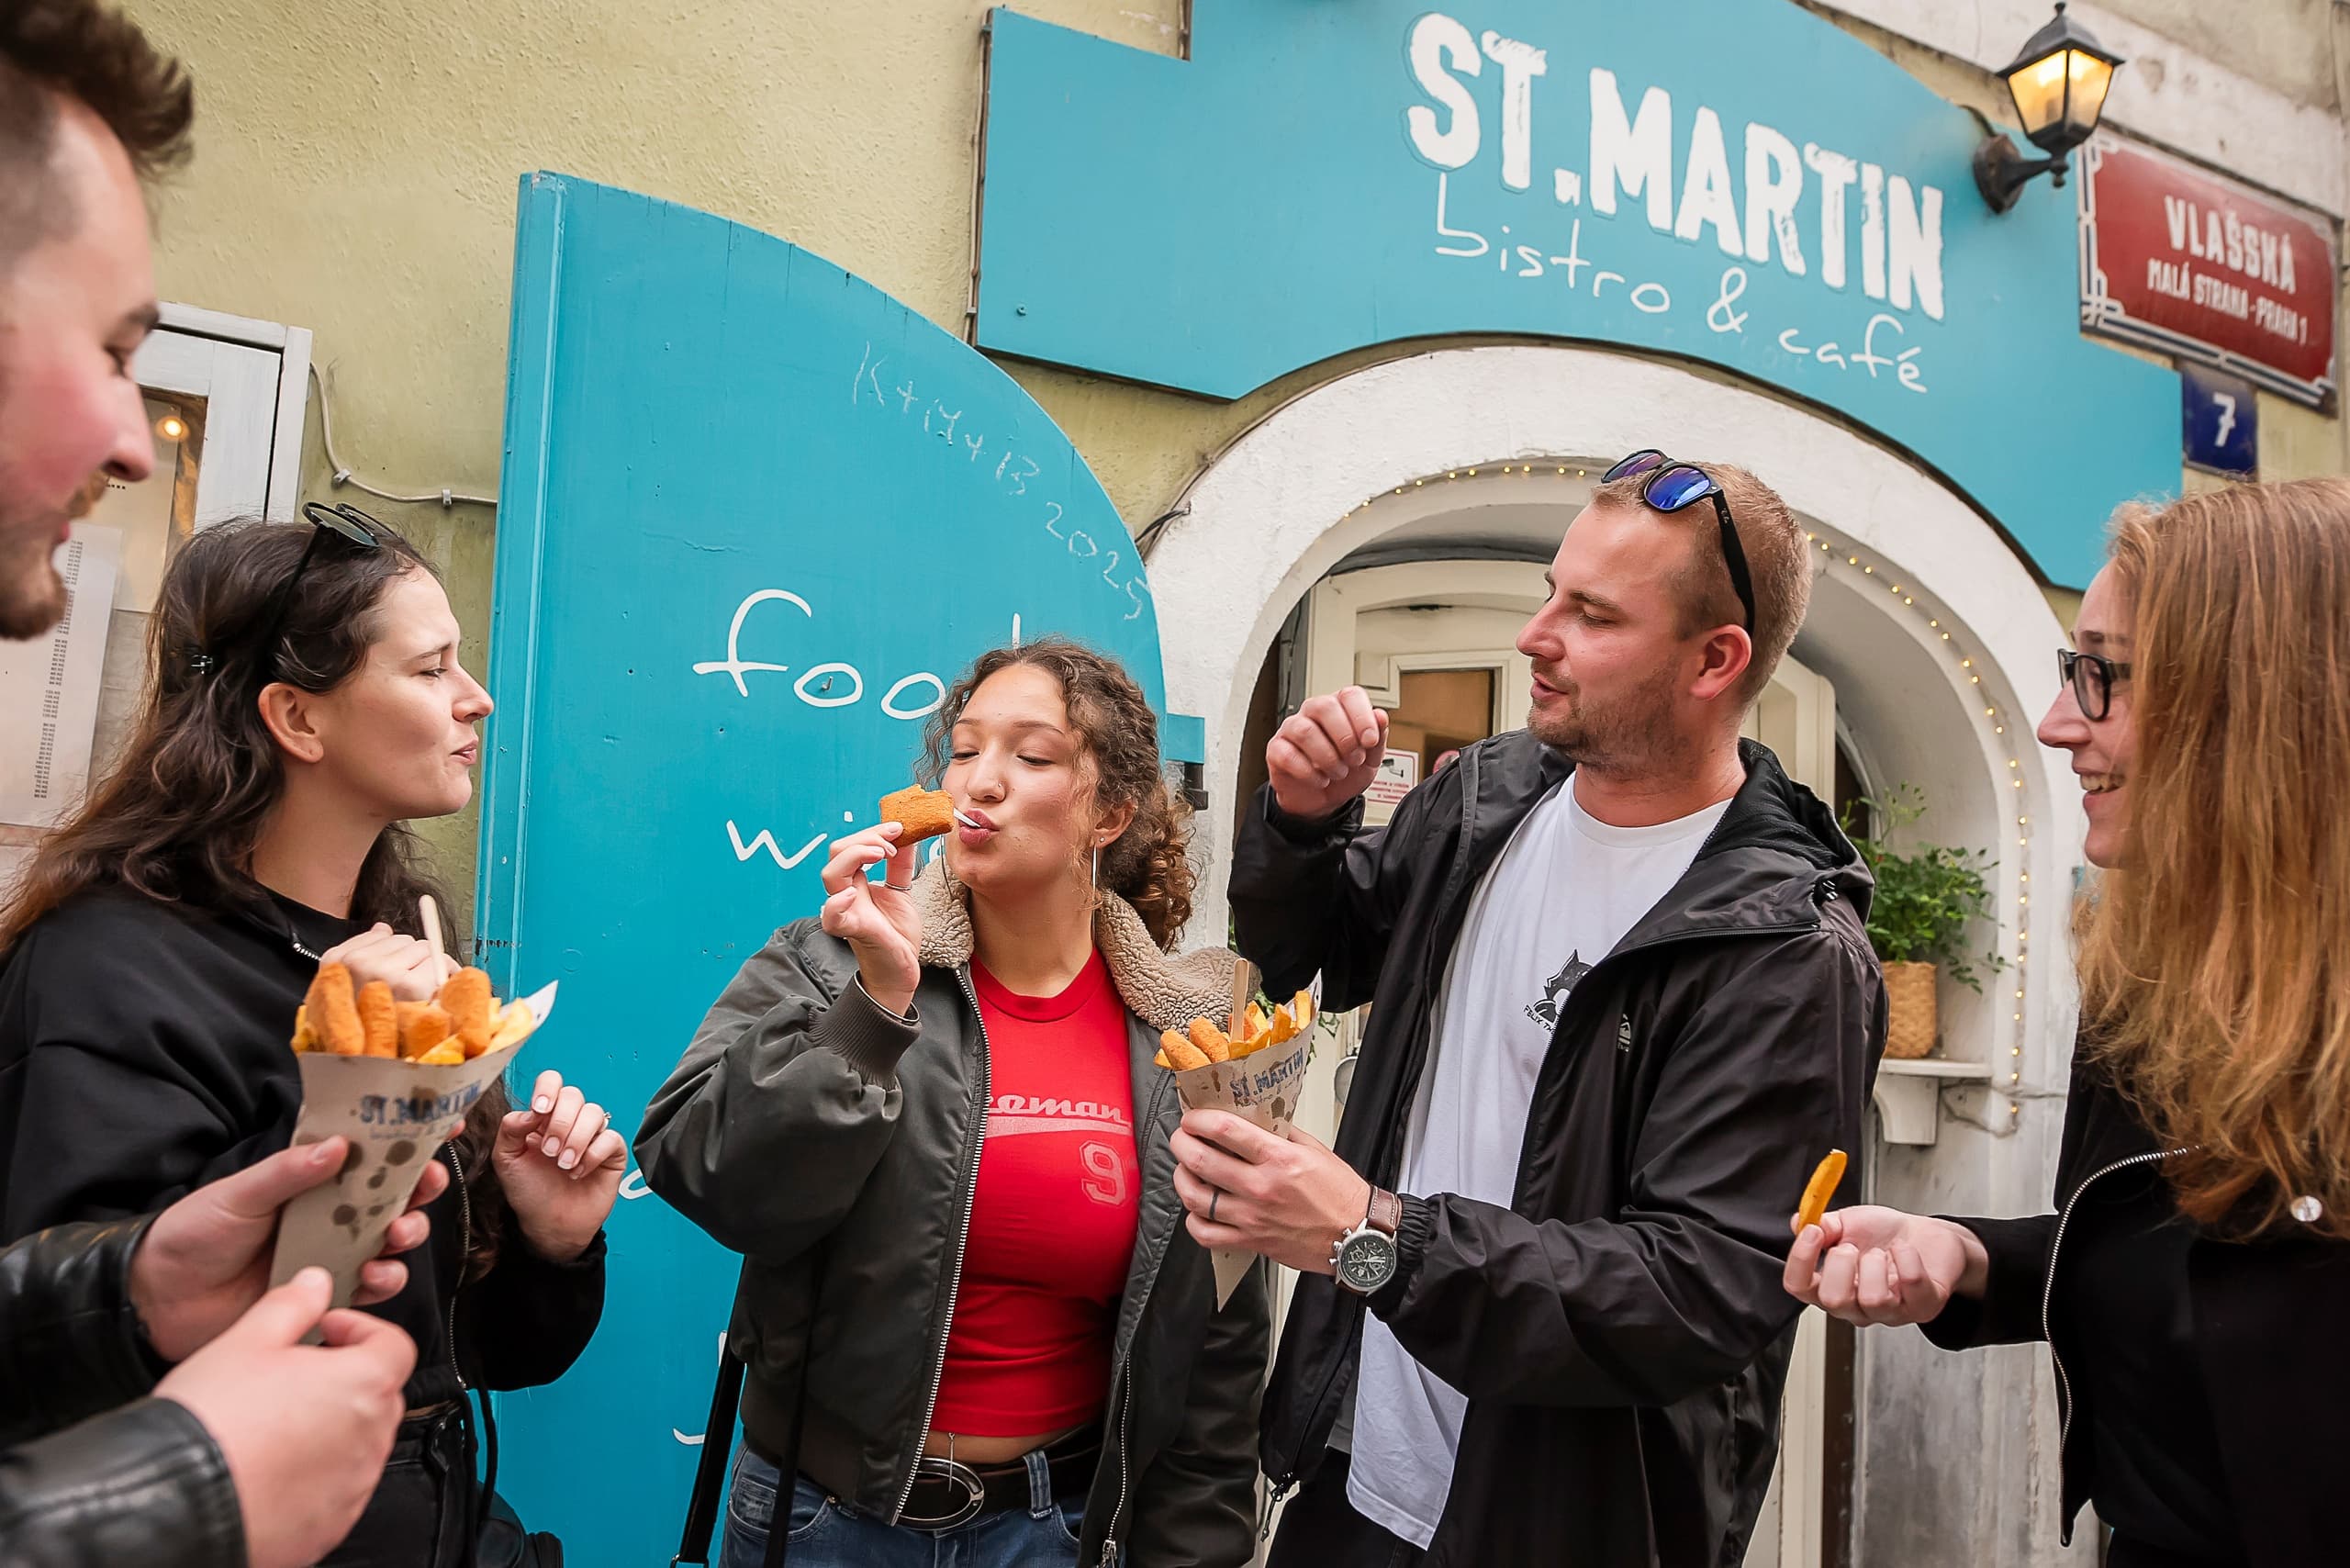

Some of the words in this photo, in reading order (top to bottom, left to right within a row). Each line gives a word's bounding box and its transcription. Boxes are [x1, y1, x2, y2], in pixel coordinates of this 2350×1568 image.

[1435, 172, 1672, 313] bistro
[1707, 267, 1749, 333] &
[1777, 314, 1928, 394] café
[2164, 195, 2296, 295] VLAŠSKÁ
[2147, 257, 2191, 301] MALÁ
[2299, 315, 2308, 347] 1
[2212, 392, 2236, 448] 7
[692, 588, 1022, 721] foo
[1078, 1139, 1126, 1208] 9
